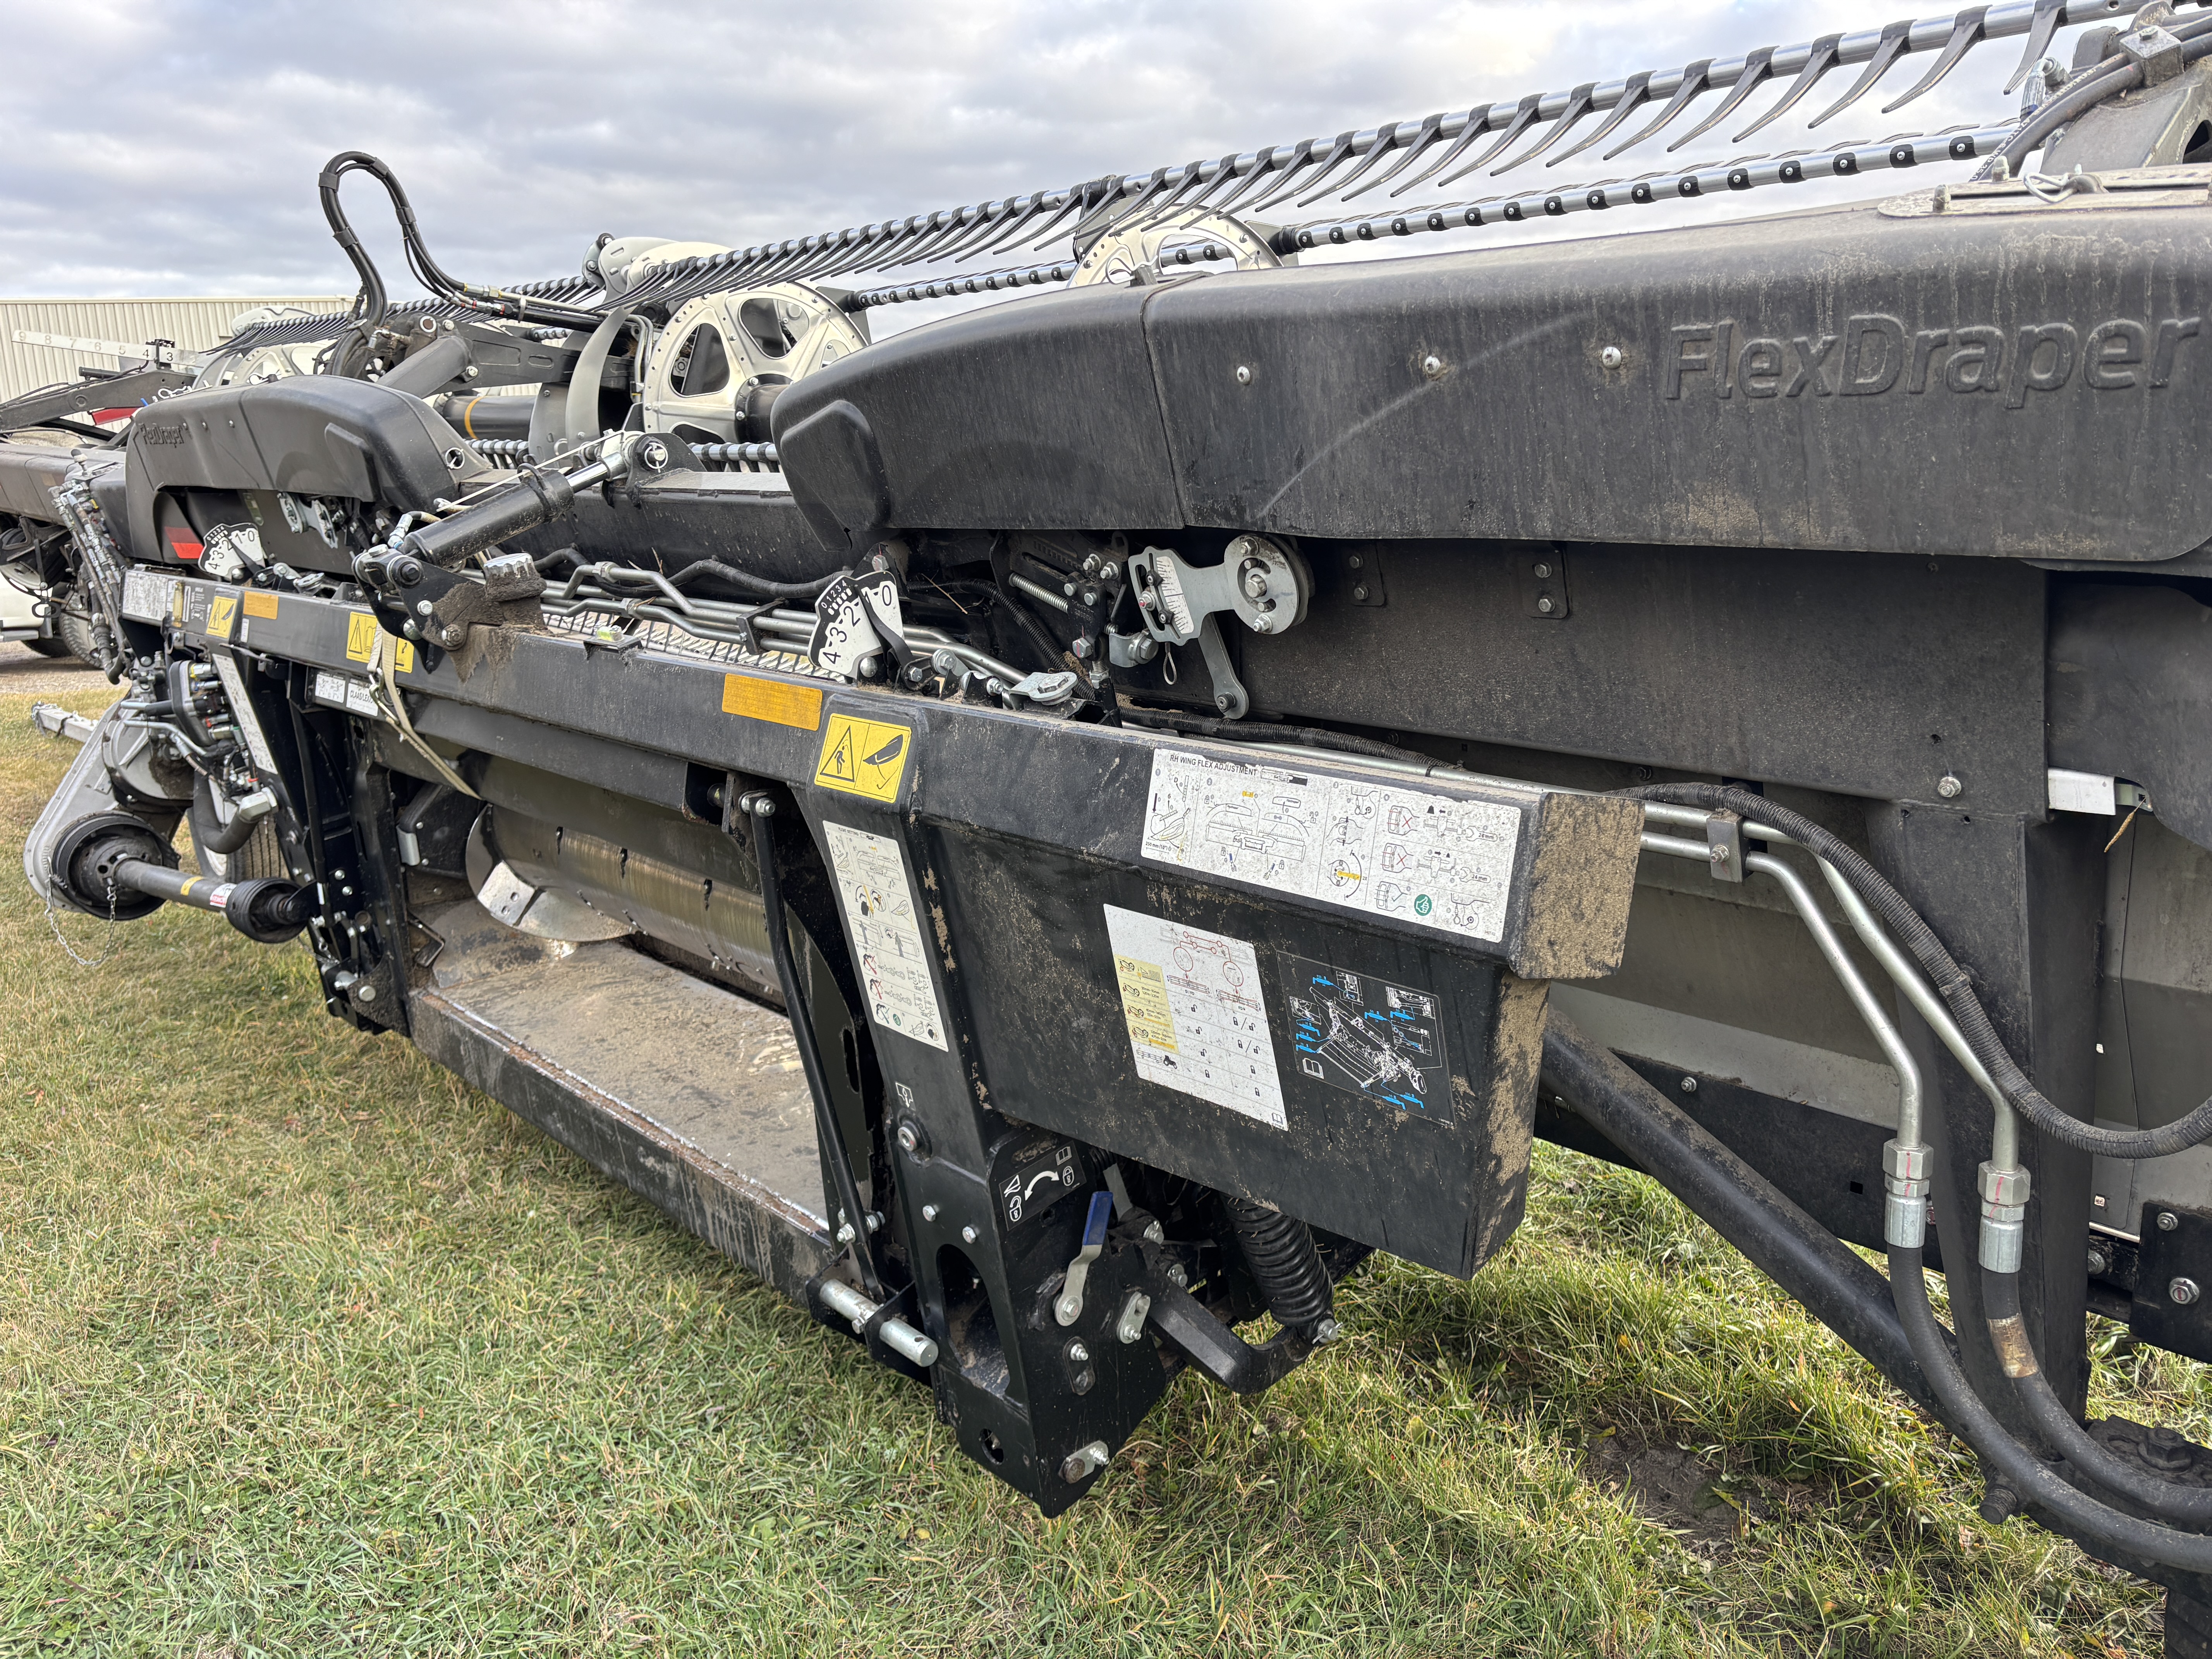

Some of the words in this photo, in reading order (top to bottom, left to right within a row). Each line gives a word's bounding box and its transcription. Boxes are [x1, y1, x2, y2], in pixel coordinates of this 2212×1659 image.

[18, 331, 26, 341] 9
[45, 335, 52, 345] 8
[70, 338, 77, 348] 7
[94, 342, 101, 351] 6
[119, 345, 126, 355] 5
[143, 349, 149, 359] 4
[167, 352, 173, 361] 3
[1665, 314, 2201, 409] FlexDraper
[139, 422, 184, 448] FlexDraper
[213, 550, 224, 559] 3
[222, 540, 233, 551] 2
[235, 533, 243, 544] 1
[248, 530, 255, 542] 0
[882, 585, 892, 606] 0
[843, 605, 861, 627] 2
[830, 627, 847, 643] 3
[823, 651, 841, 665] 4
[1170, 754, 1179, 763] RH
[1180, 756, 1196, 766] WING
[1198, 759, 1212, 769] FLEX
[1214, 763, 1257, 776] ADJUSTMENT
